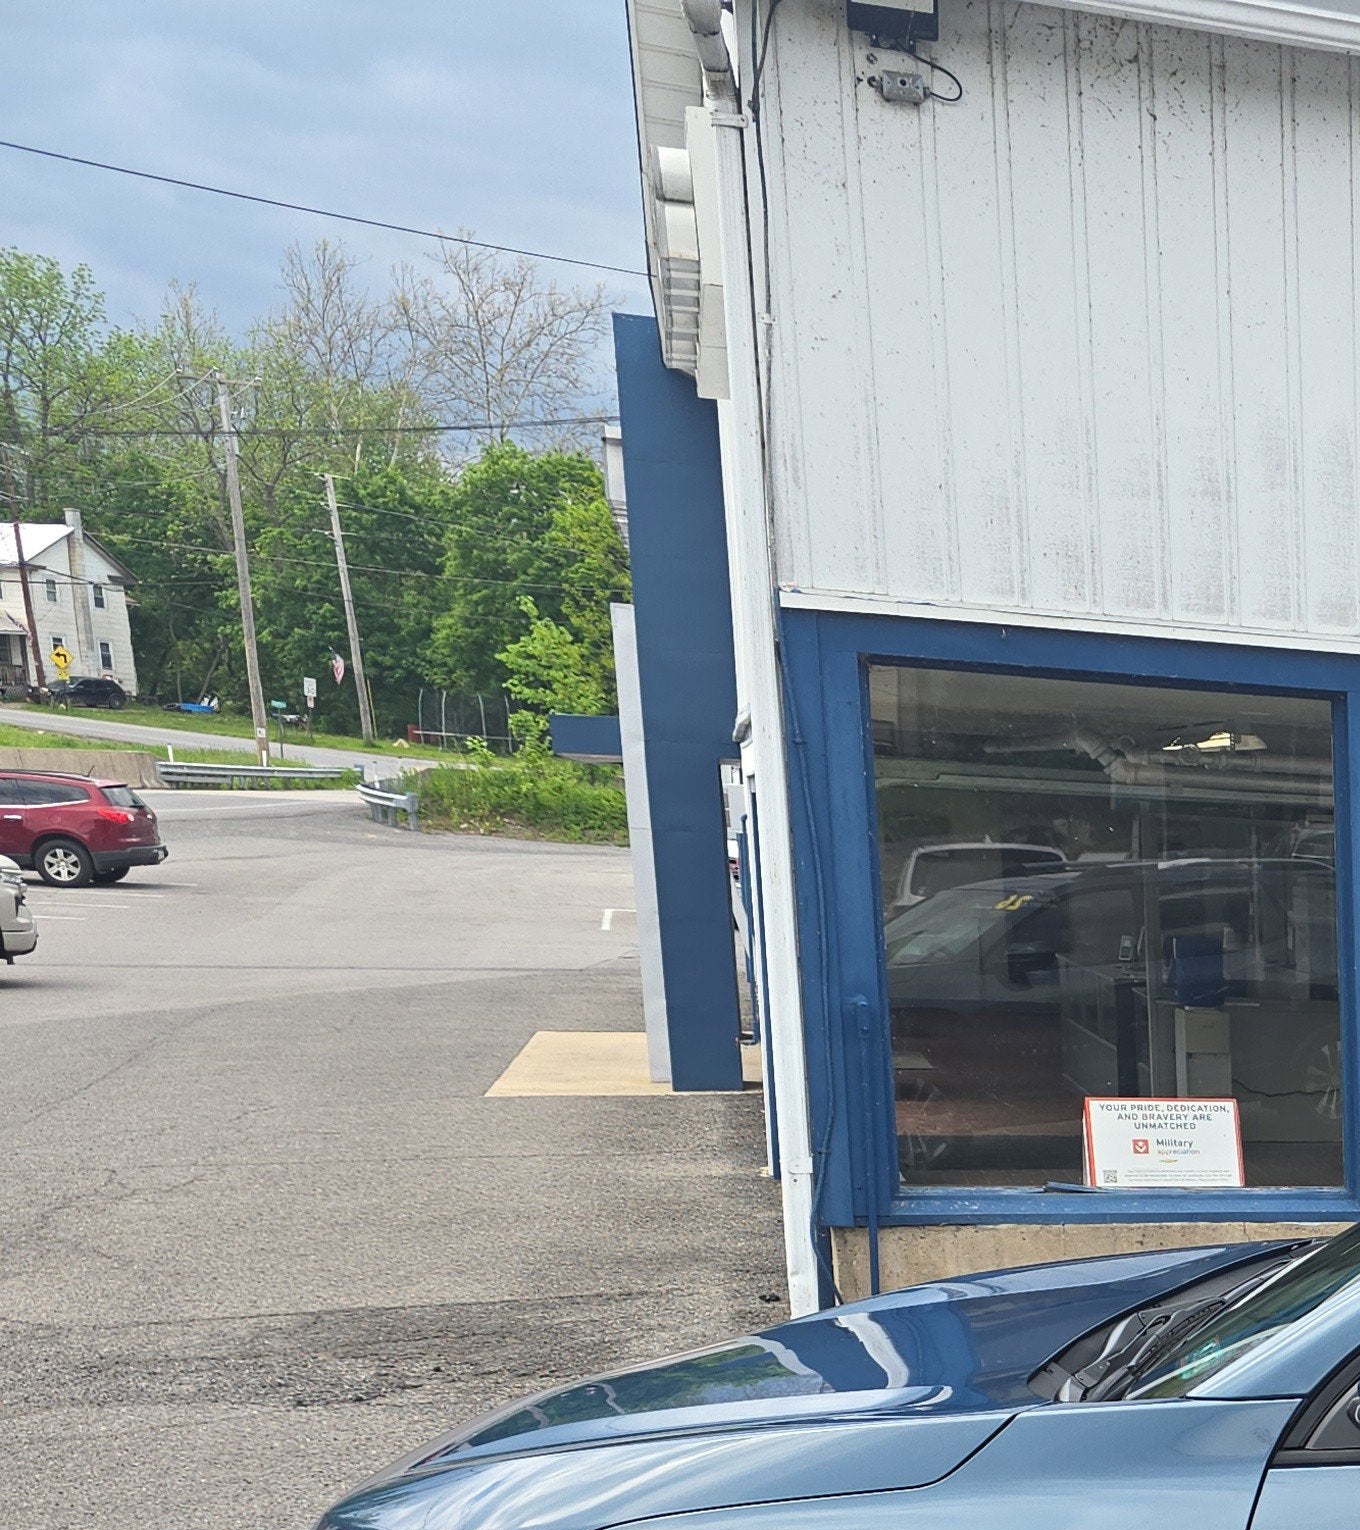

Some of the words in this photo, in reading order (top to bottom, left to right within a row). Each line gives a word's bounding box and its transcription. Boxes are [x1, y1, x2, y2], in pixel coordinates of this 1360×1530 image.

[1130, 1104, 1164, 1112] PRIDE,
[1167, 1105, 1230, 1113] DEDICATION,
[1117, 1113, 1138, 1121] AND
[1142, 1113, 1188, 1121] BRAVERY
[1134, 1122, 1196, 1130] UNMATCHED
[1156, 1138, 1193, 1148] Military
